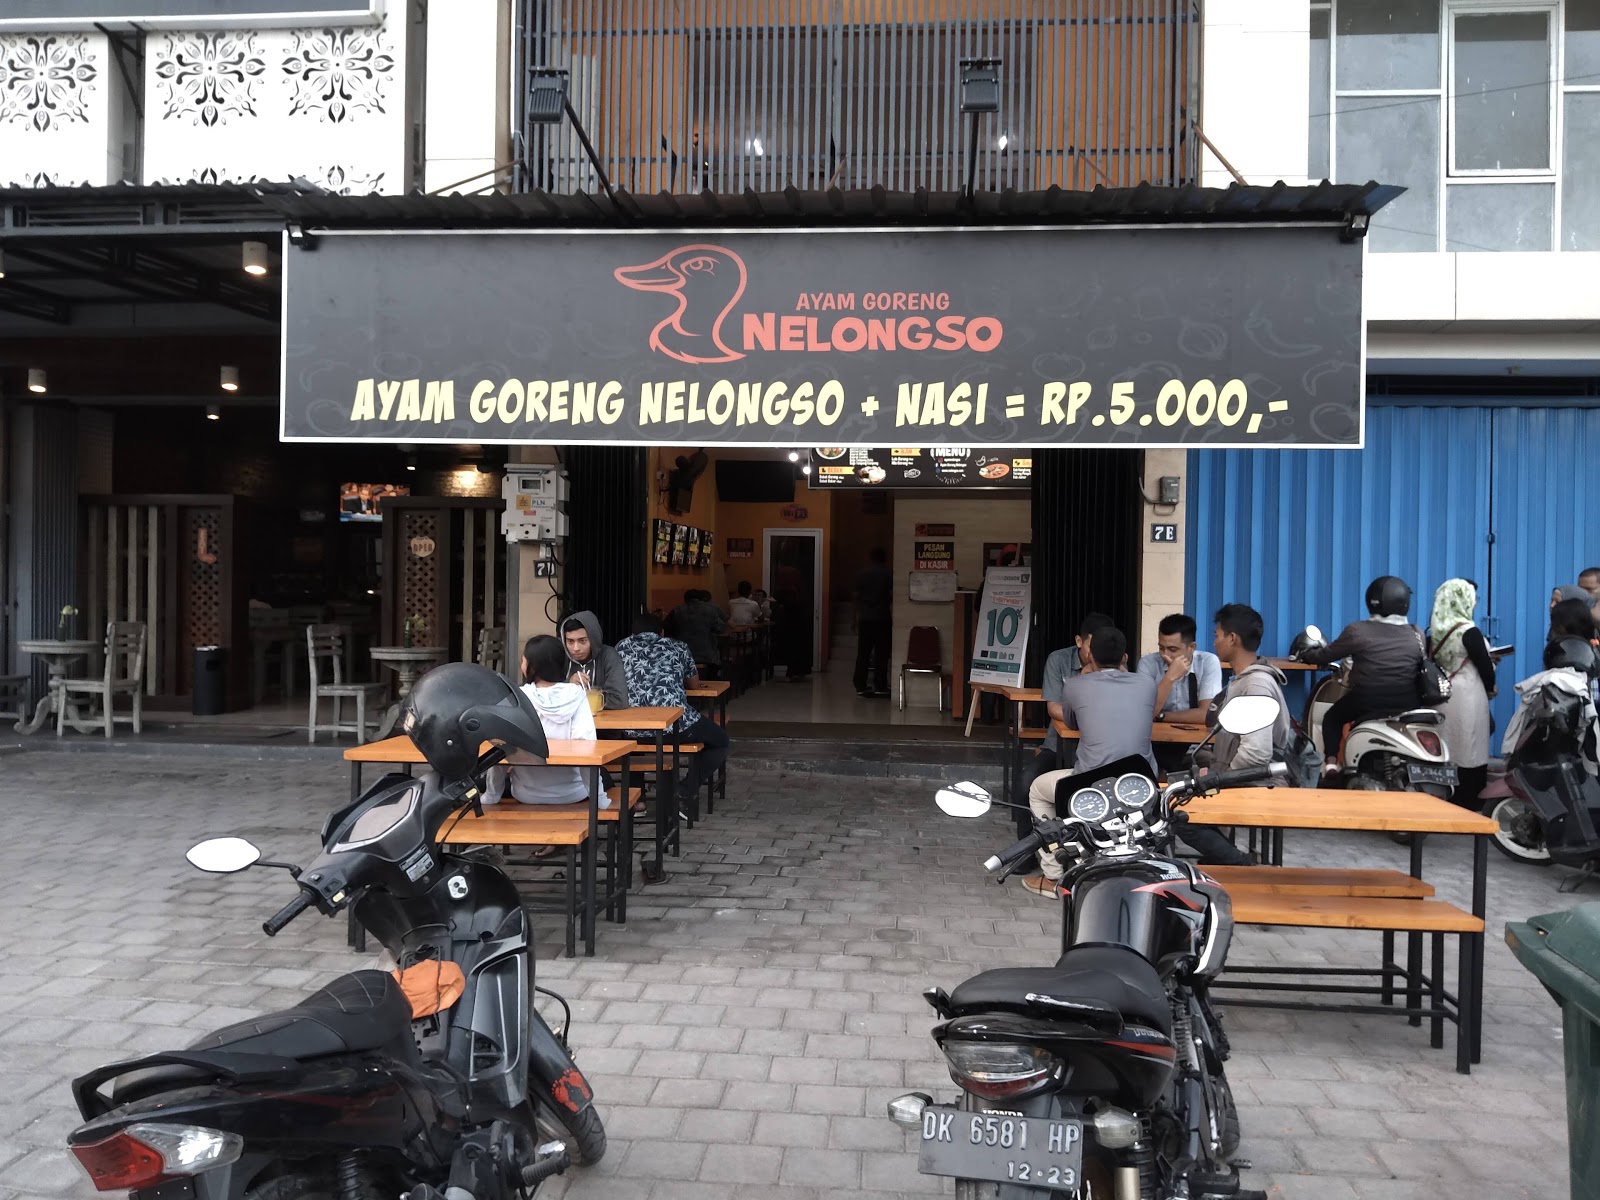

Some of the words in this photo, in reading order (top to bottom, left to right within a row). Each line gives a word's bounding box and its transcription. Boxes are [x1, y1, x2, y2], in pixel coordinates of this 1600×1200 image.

[796, 292, 855, 311] AYAM
[862, 292, 950, 311] GORENG
[743, 312, 1003, 352] NELONGSO
[350, 378, 456, 424] AYAM
[469, 378, 625, 427] GORENG
[639, 379, 845, 427] NELONGSO
[861, 395, 880, 417] +
[895, 382, 989, 428] NASI
[1040, 378, 1289, 434] RP.5.000,-
[413, 543, 433, 552] OPEN
[923, 543, 945, 551] PESAN
[917, 551, 951, 559] LANGSUNG
[919, 560, 927, 569] DI
[927, 560, 949, 569] KASIR
[1160, 872, 1187, 880] HONDA
[922, 1110, 955, 1143] DK
[969, 1115, 1028, 1150] 6581
[1048, 1123, 1080, 1153] HP
